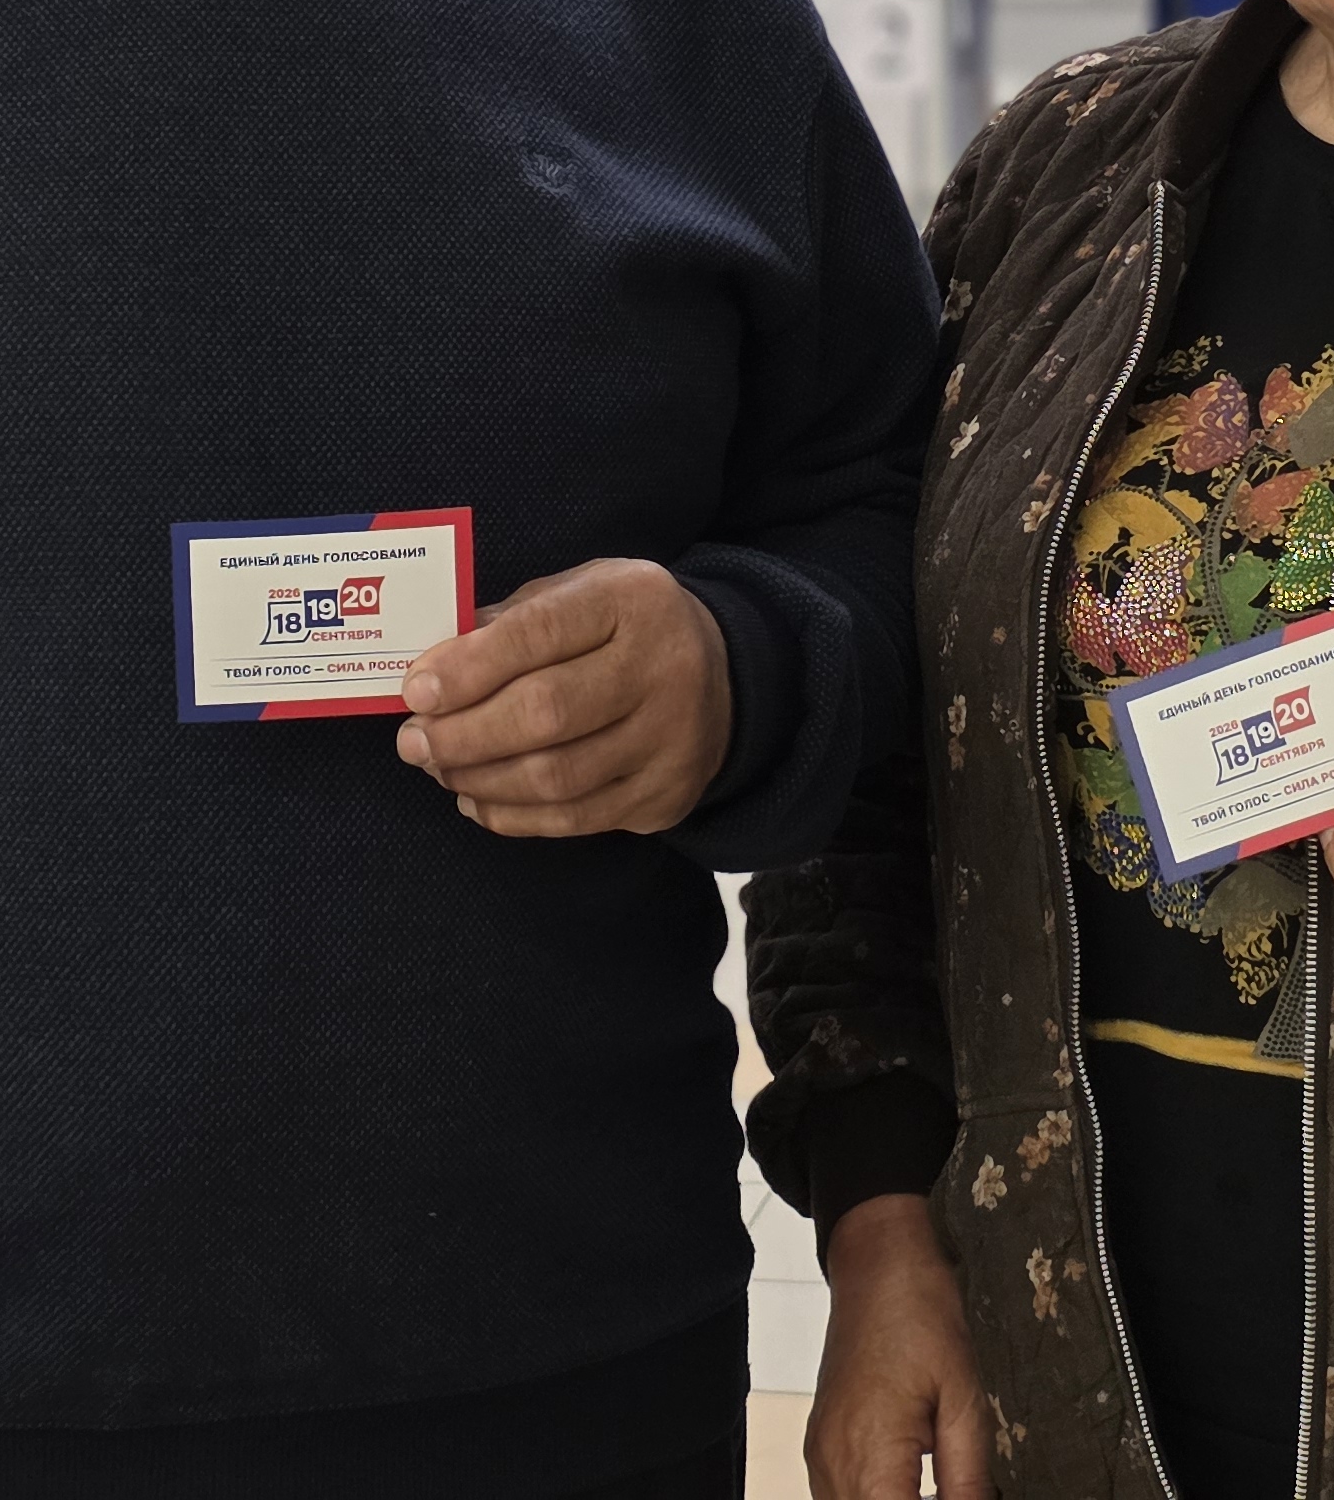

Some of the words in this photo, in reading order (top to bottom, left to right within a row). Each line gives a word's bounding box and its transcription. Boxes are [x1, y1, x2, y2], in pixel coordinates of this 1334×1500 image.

[220, 553, 280, 569] ЕДИНЫЙ
[283, 554, 320, 567] ДЕНЬ
[323, 547, 426, 563] ГОЛОСОВАНИЯ
[268, 588, 301, 599] 2026
[273, 612, 302, 634] 18
[307, 598, 336, 620] 19
[342, 585, 378, 608] 20
[311, 629, 382, 642] СЕНТЯБРЯ
[223, 665, 262, 678] ТВОЙ
[266, 664, 311, 677] ГОЛОС
[326, 662, 365, 673] СИЛА
[1158, 691, 1211, 721] ЕДИНЫЙ
[1213, 682, 1247, 703] ДЕНЬ
[1209, 720, 1239, 738] 2026
[1221, 744, 1249, 770] 18
[1247, 721, 1276, 748] 19
[1275, 697, 1310, 727] 20
[1259, 738, 1326, 769] СЕНТЯБРЯ
[1191, 806, 1227, 828] ТВОЙ
[1229, 793, 1271, 816] ГОЛОС
[1283, 776, 1319, 796] СИЛА
